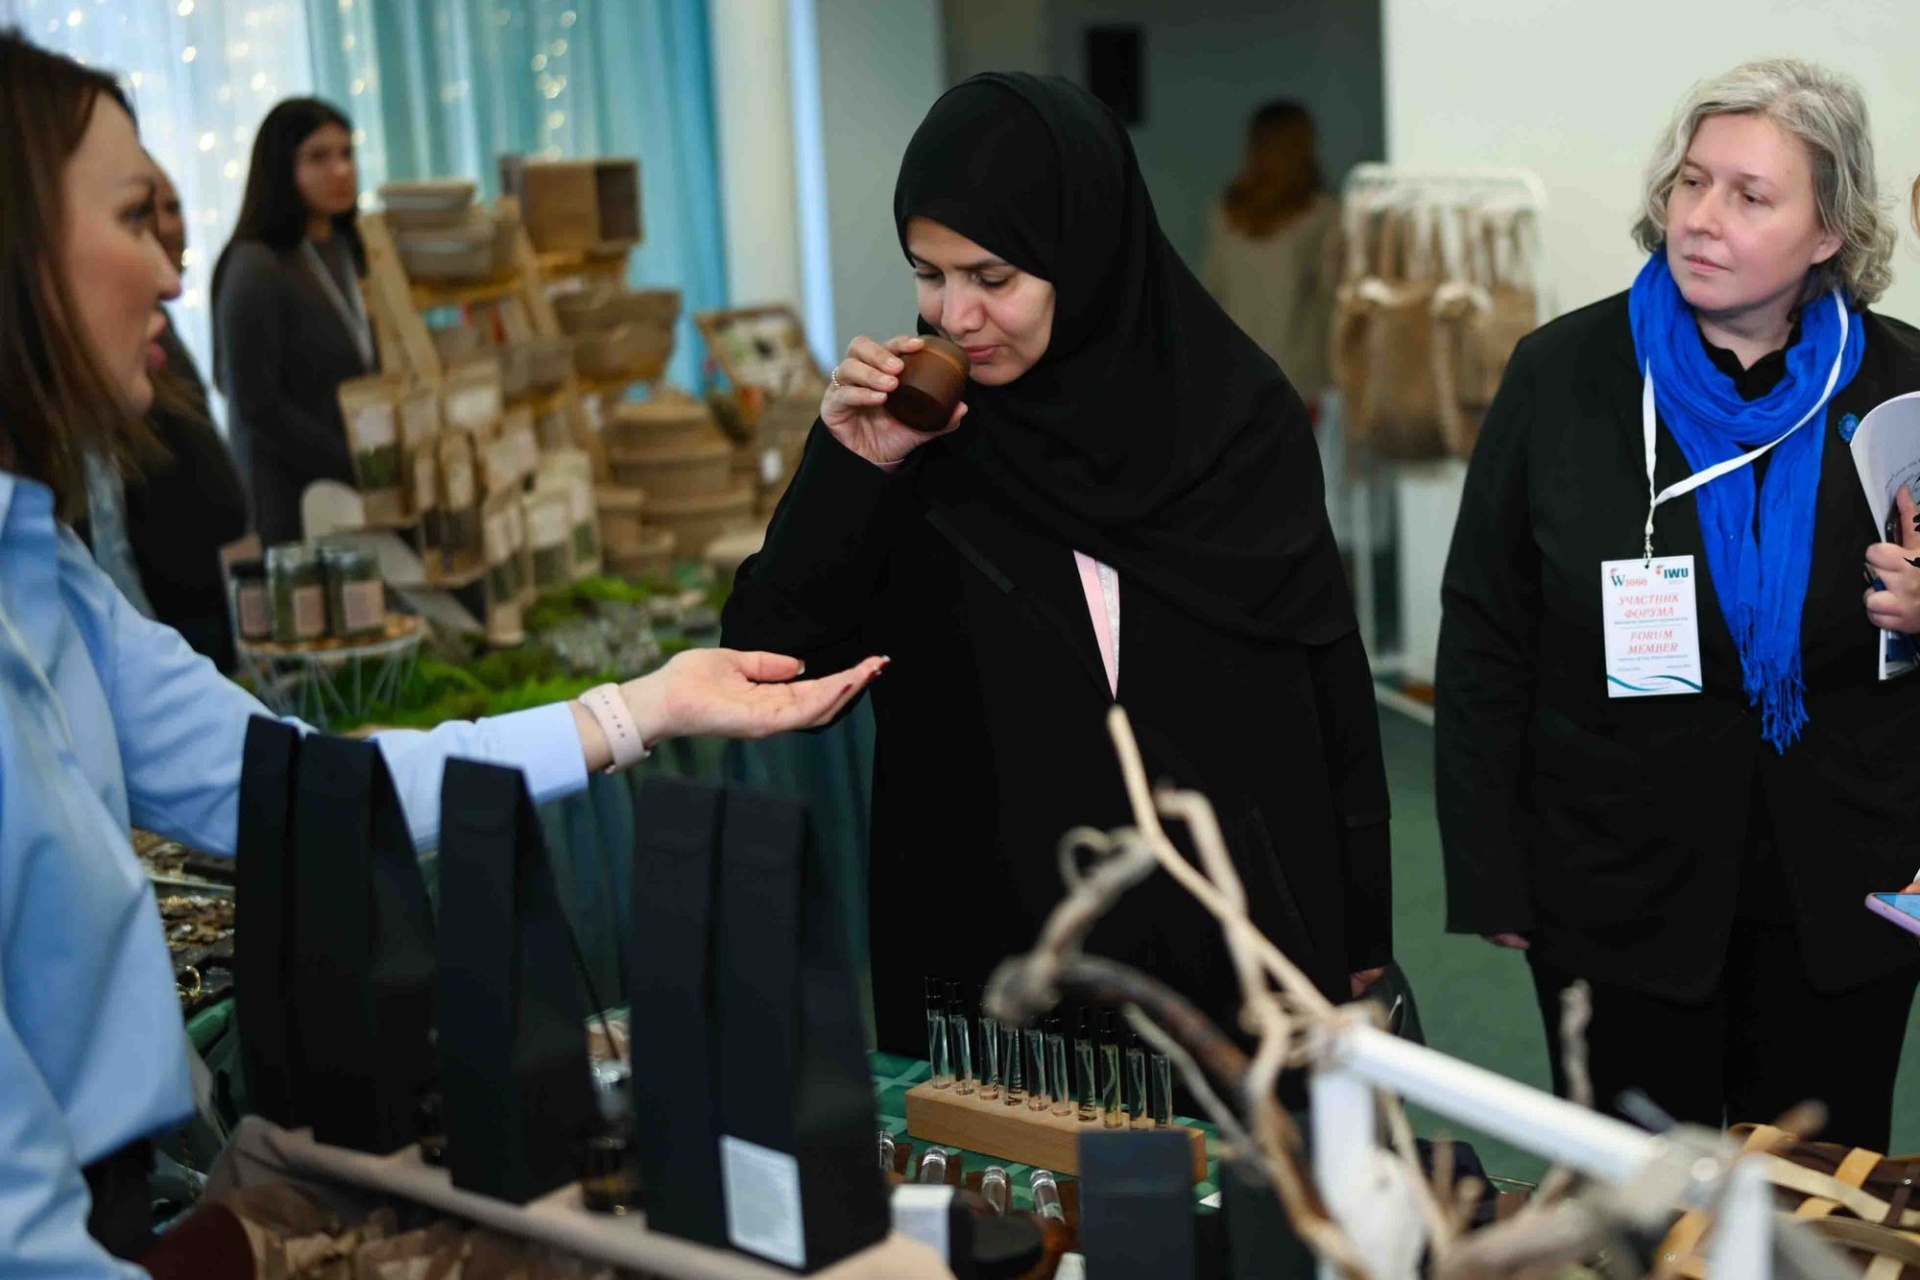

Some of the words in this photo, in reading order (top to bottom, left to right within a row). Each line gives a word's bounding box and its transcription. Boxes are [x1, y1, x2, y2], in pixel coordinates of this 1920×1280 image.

[1664, 568, 1689, 579] IWU
[1618, 594, 1679, 606] УЧАСТНИК
[1624, 607, 1674, 618] ФОРУМА
[1630, 630, 1673, 642] FORUM
[1628, 643, 1678, 654] MEMBER
